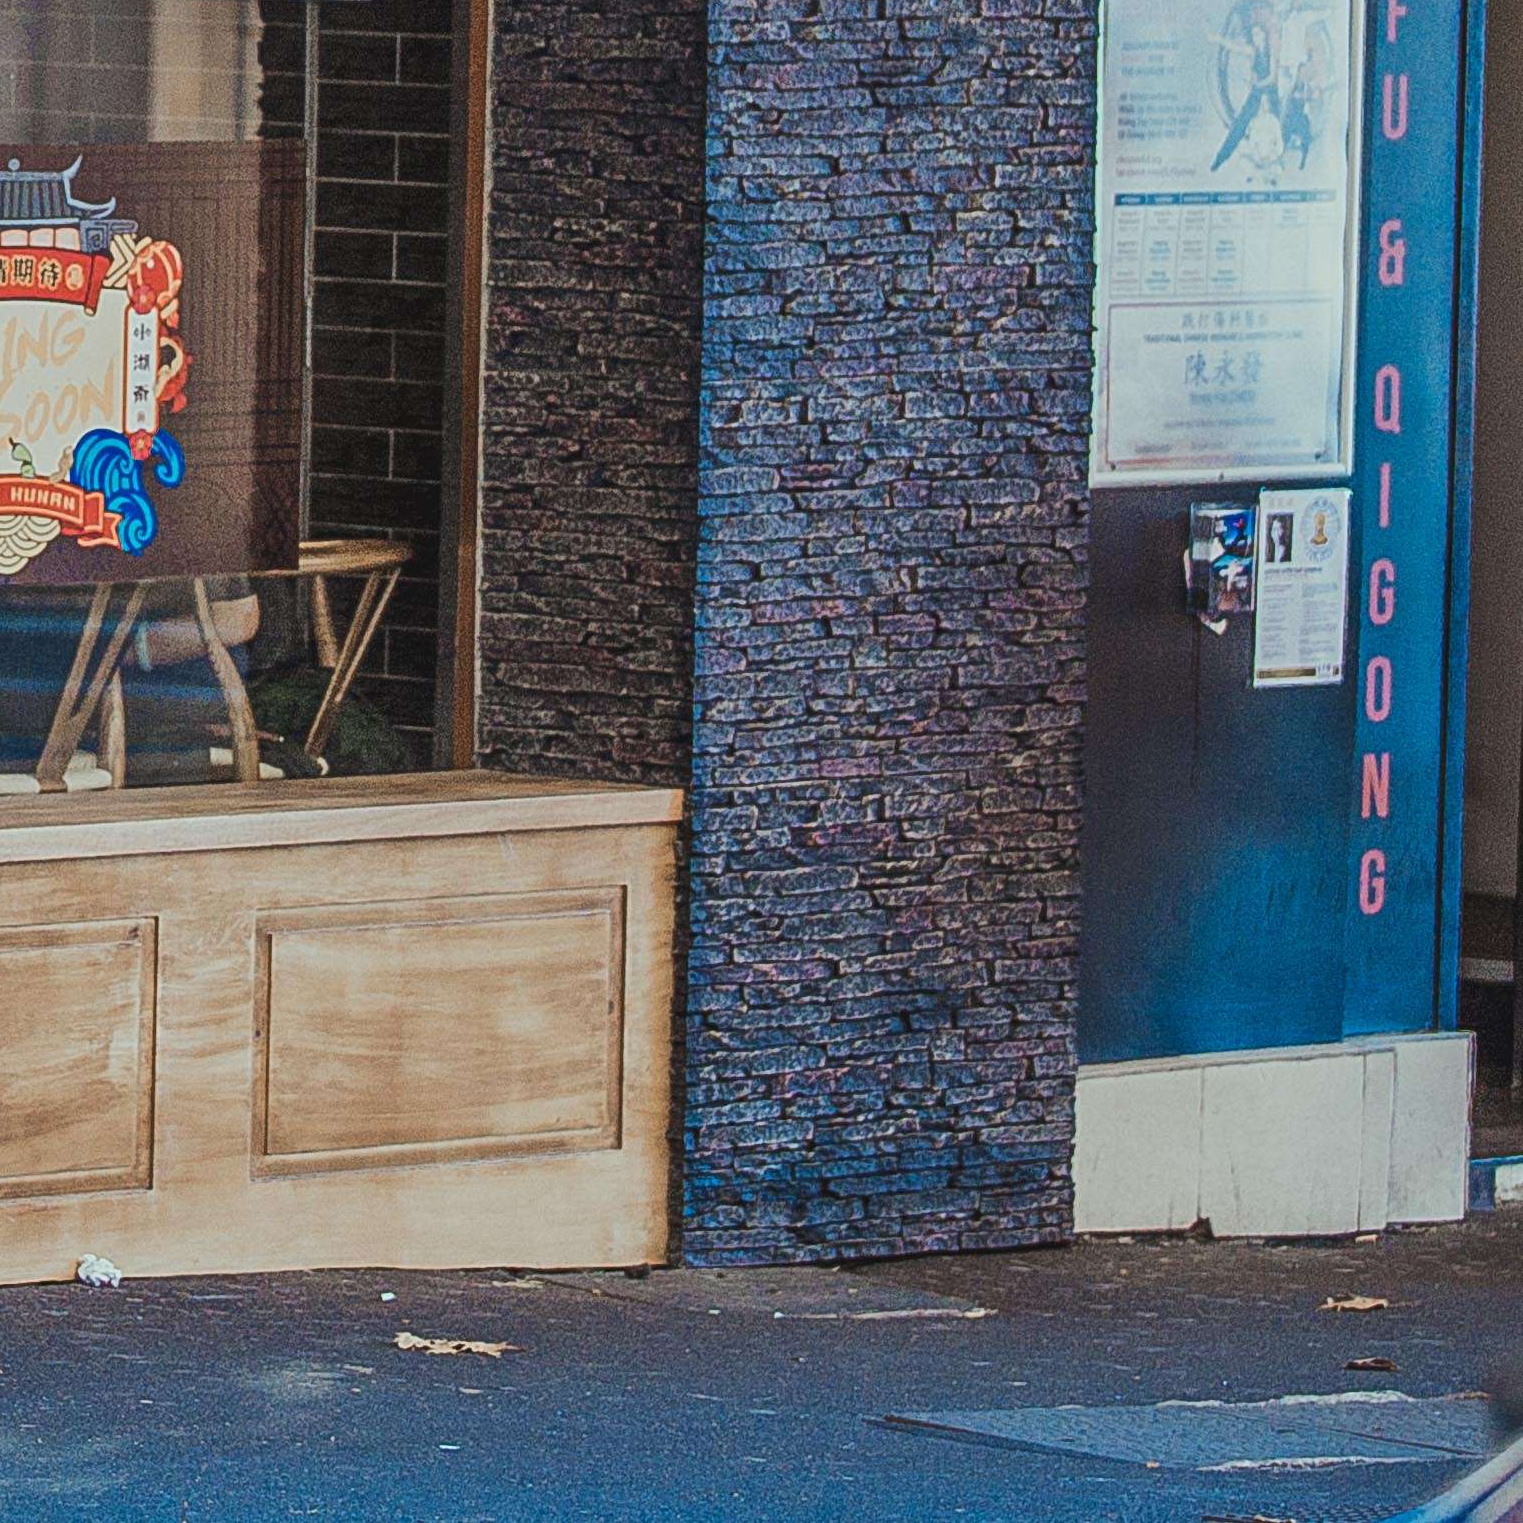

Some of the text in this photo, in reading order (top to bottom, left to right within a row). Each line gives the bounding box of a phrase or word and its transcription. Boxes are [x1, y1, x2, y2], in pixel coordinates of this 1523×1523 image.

[1376, 219, 1405, 288] &
[11, 487, 76, 511] HUNAN
[1358, 364, 1402, 916] QIGONG
